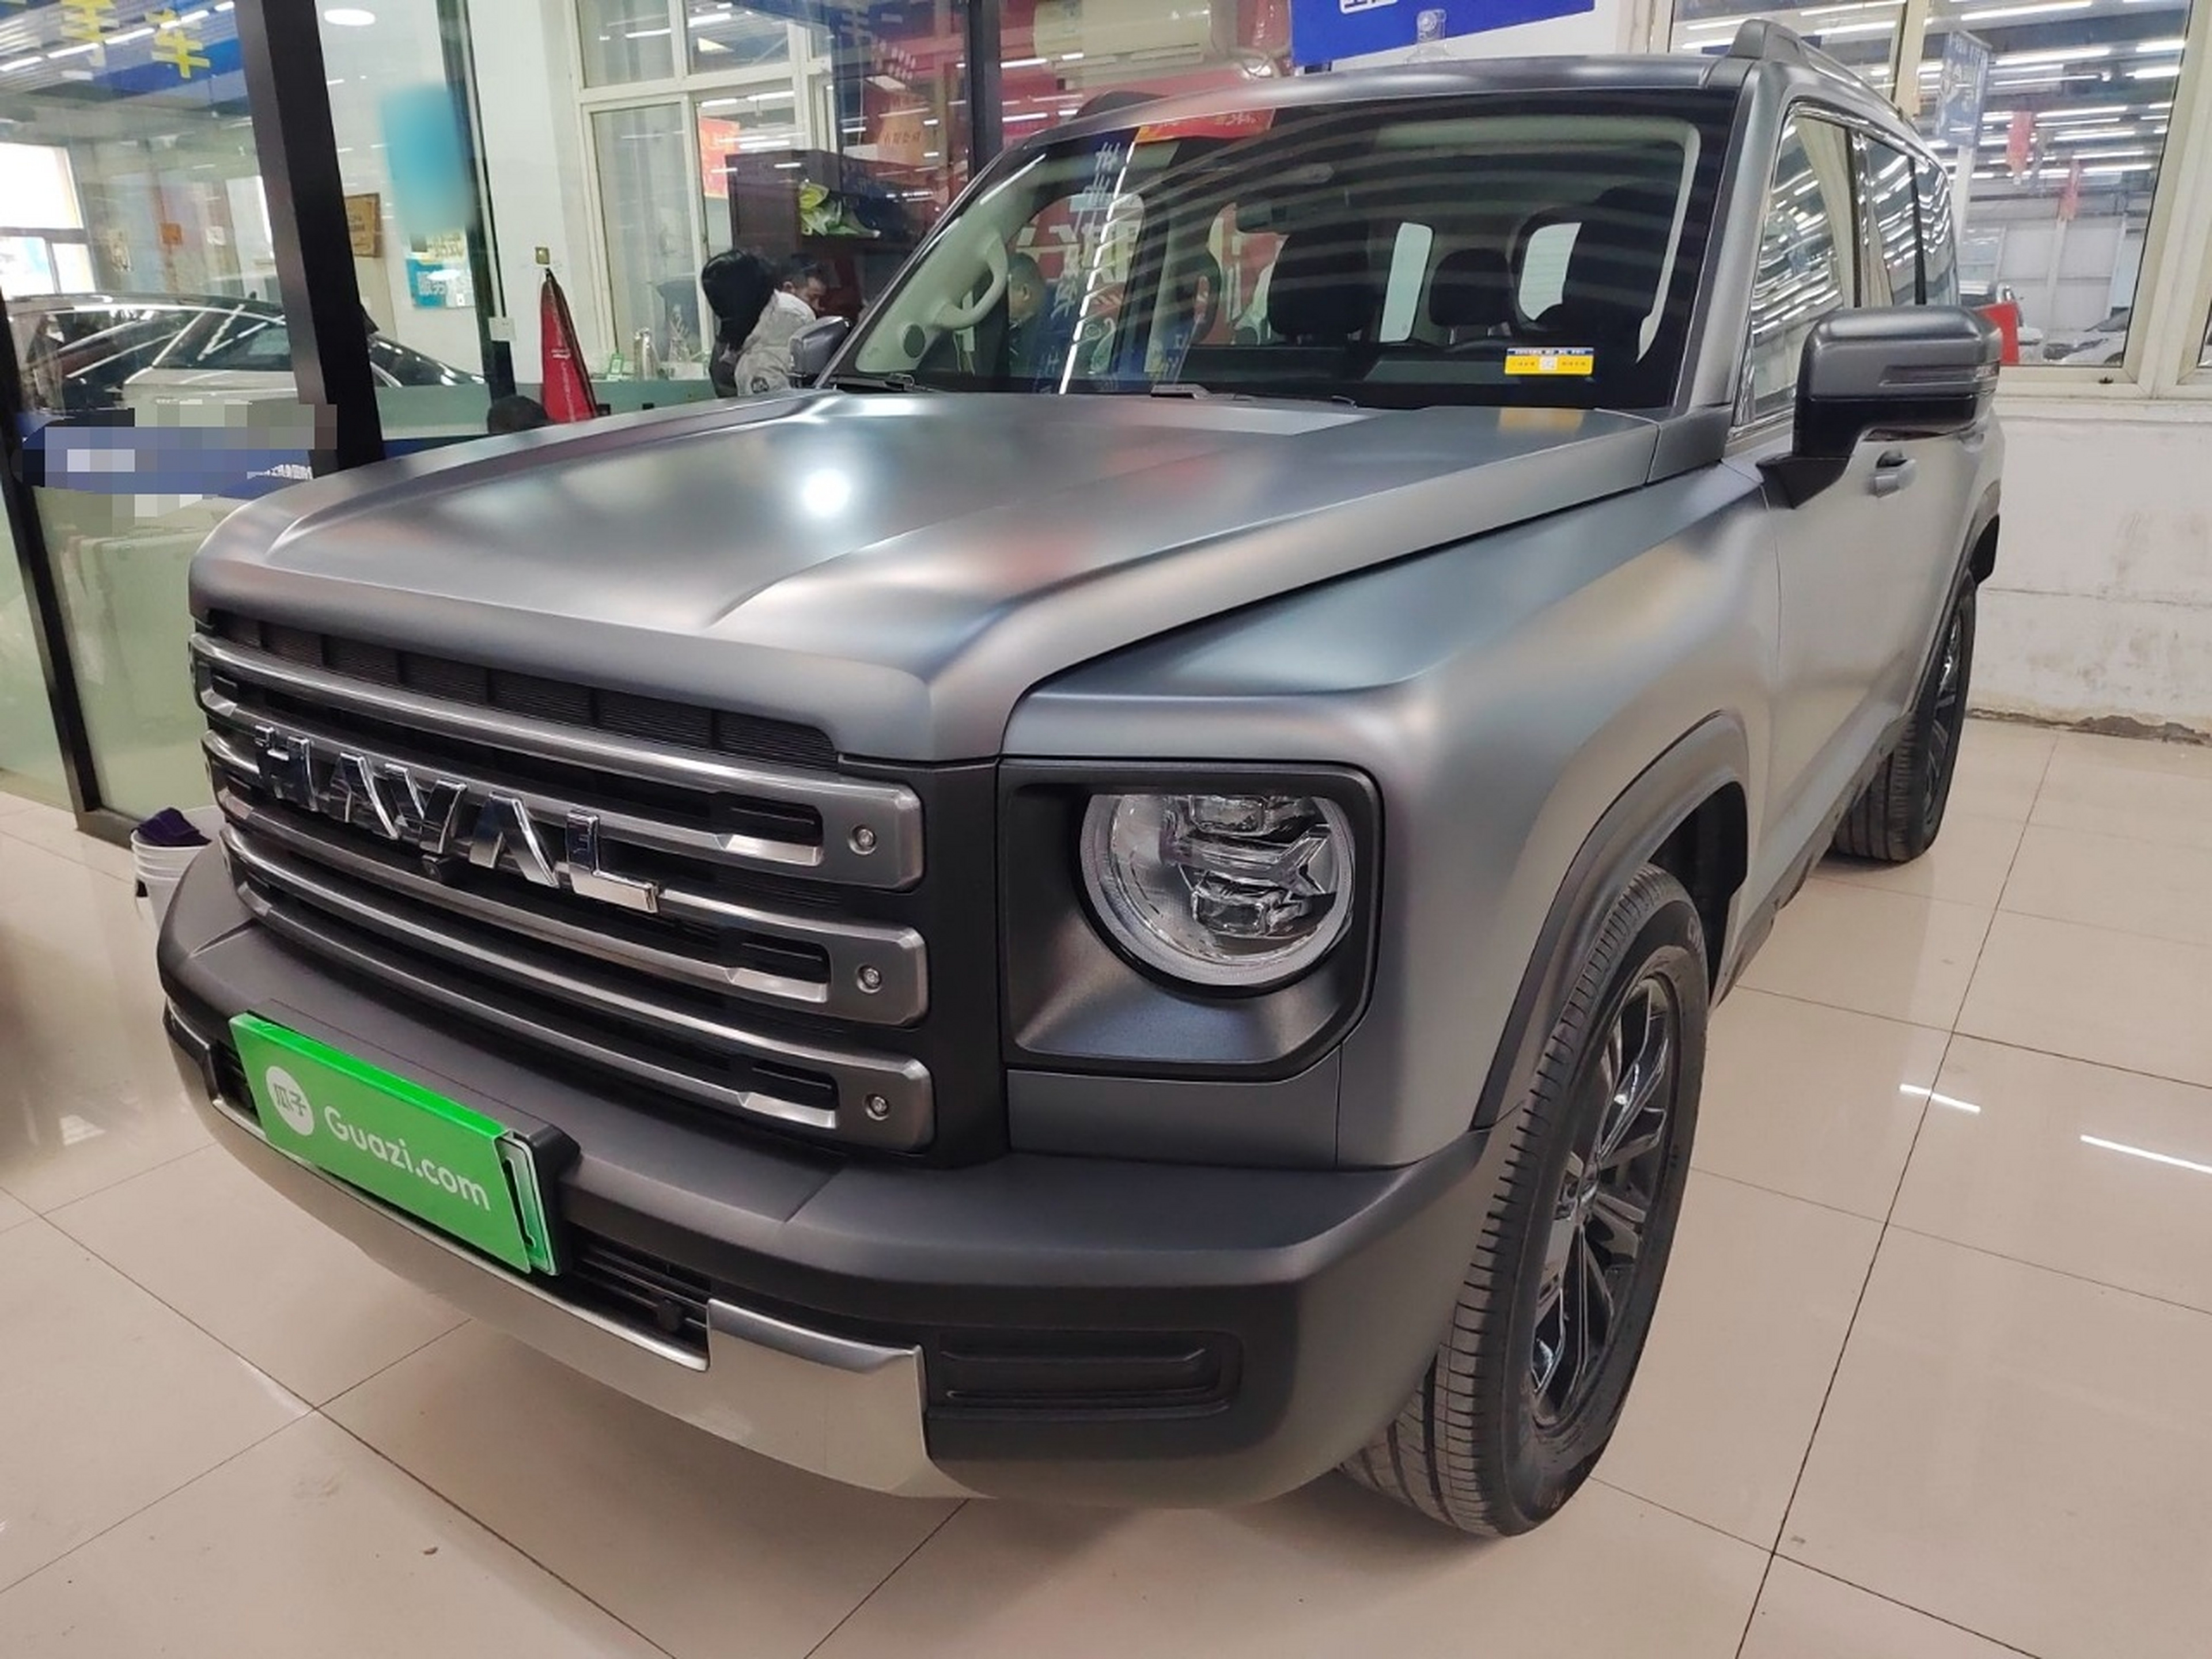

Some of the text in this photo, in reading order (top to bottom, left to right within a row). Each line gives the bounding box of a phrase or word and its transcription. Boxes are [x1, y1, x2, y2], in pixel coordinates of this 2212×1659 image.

[255, 726, 660, 914] HAVAL
[273, 1084, 307, 1118] 瓜子
[324, 1106, 491, 1211] Guazi.com
